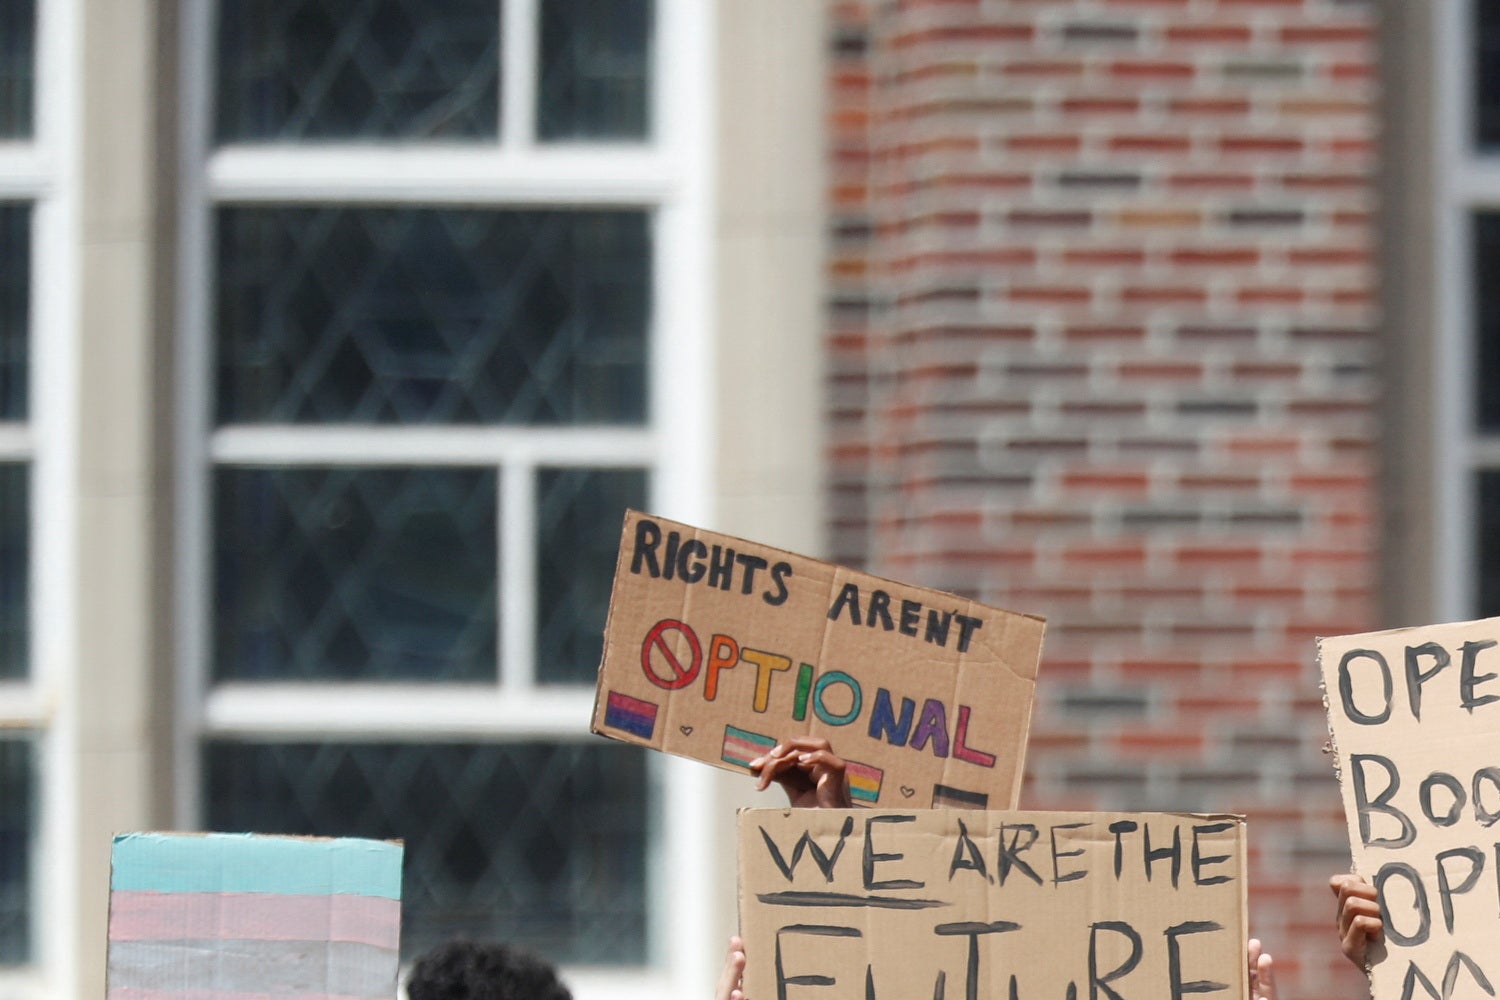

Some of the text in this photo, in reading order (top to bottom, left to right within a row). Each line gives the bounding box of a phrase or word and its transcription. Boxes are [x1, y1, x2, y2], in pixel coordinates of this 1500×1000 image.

[630, 519, 793, 606] RIGHTS
[757, 816, 1236, 890] WE ARE THE
